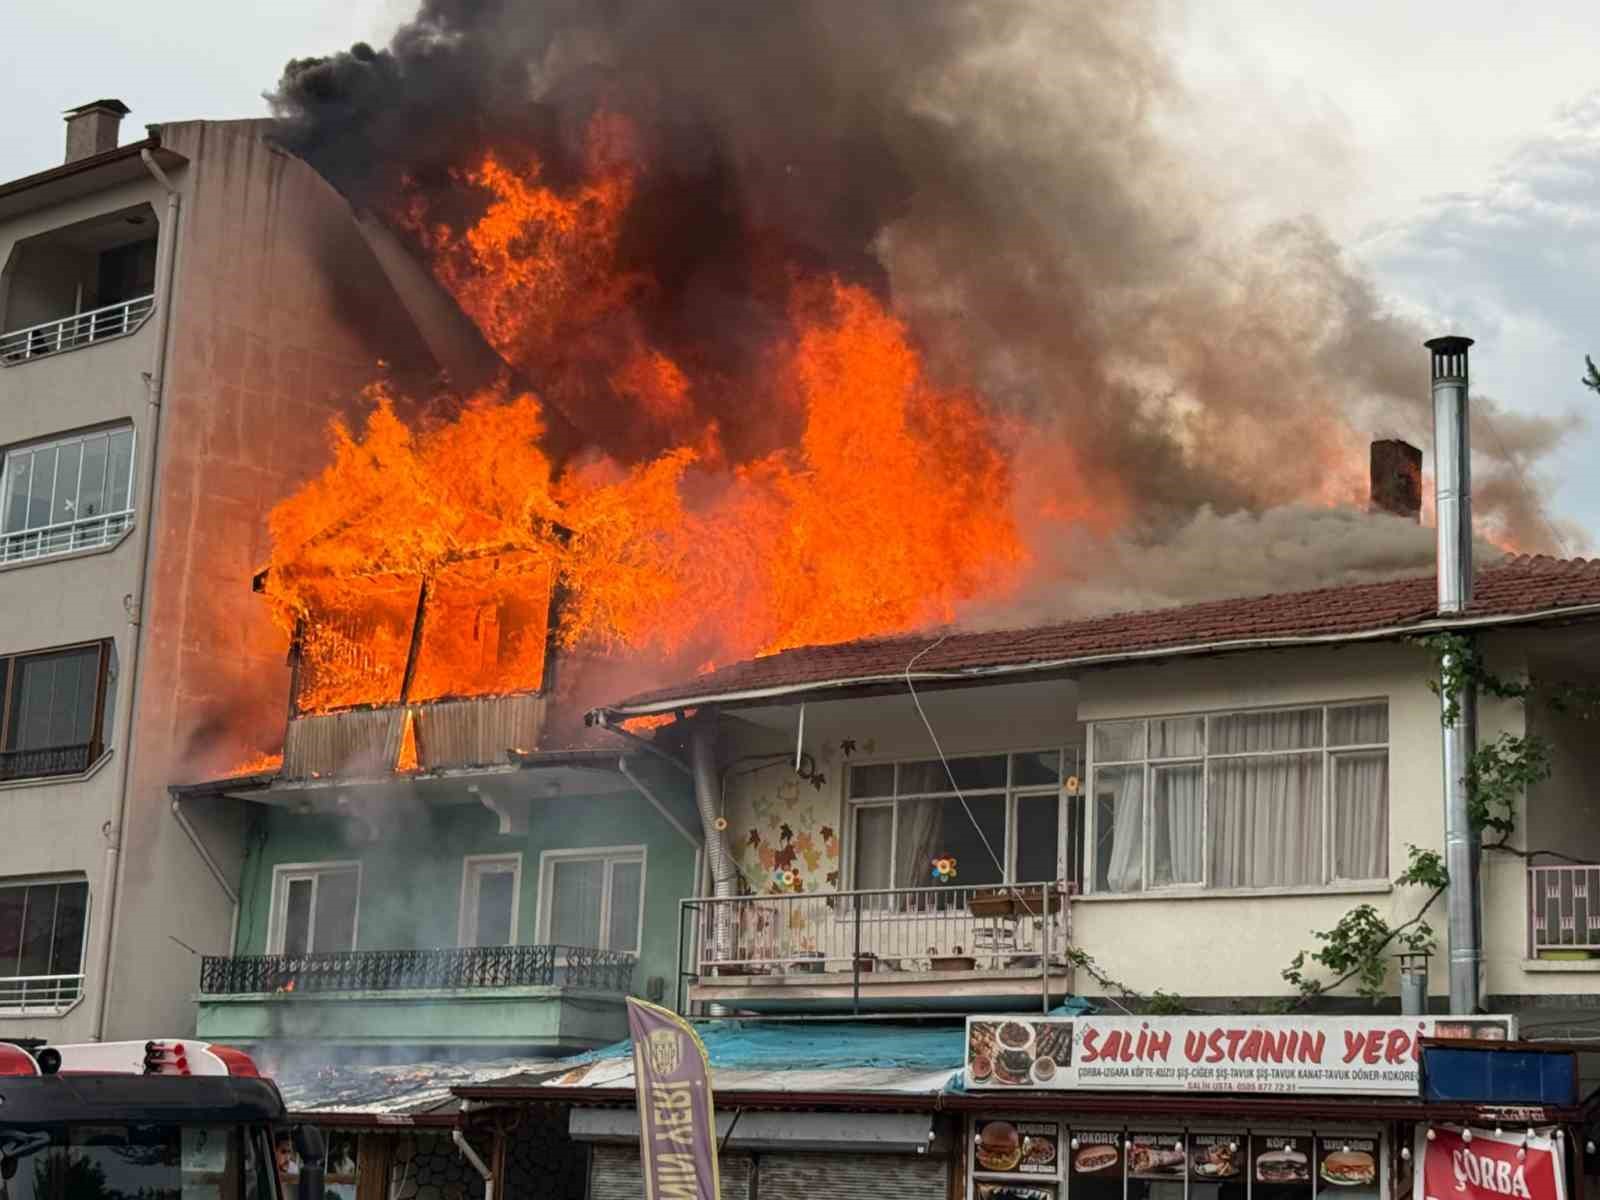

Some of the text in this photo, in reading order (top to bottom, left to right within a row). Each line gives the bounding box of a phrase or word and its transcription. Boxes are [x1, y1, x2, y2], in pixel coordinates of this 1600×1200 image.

[1080, 1021, 1426, 1065] SALİH USTANIN YERİ
[1452, 1148, 1532, 1200] ÇORBA
